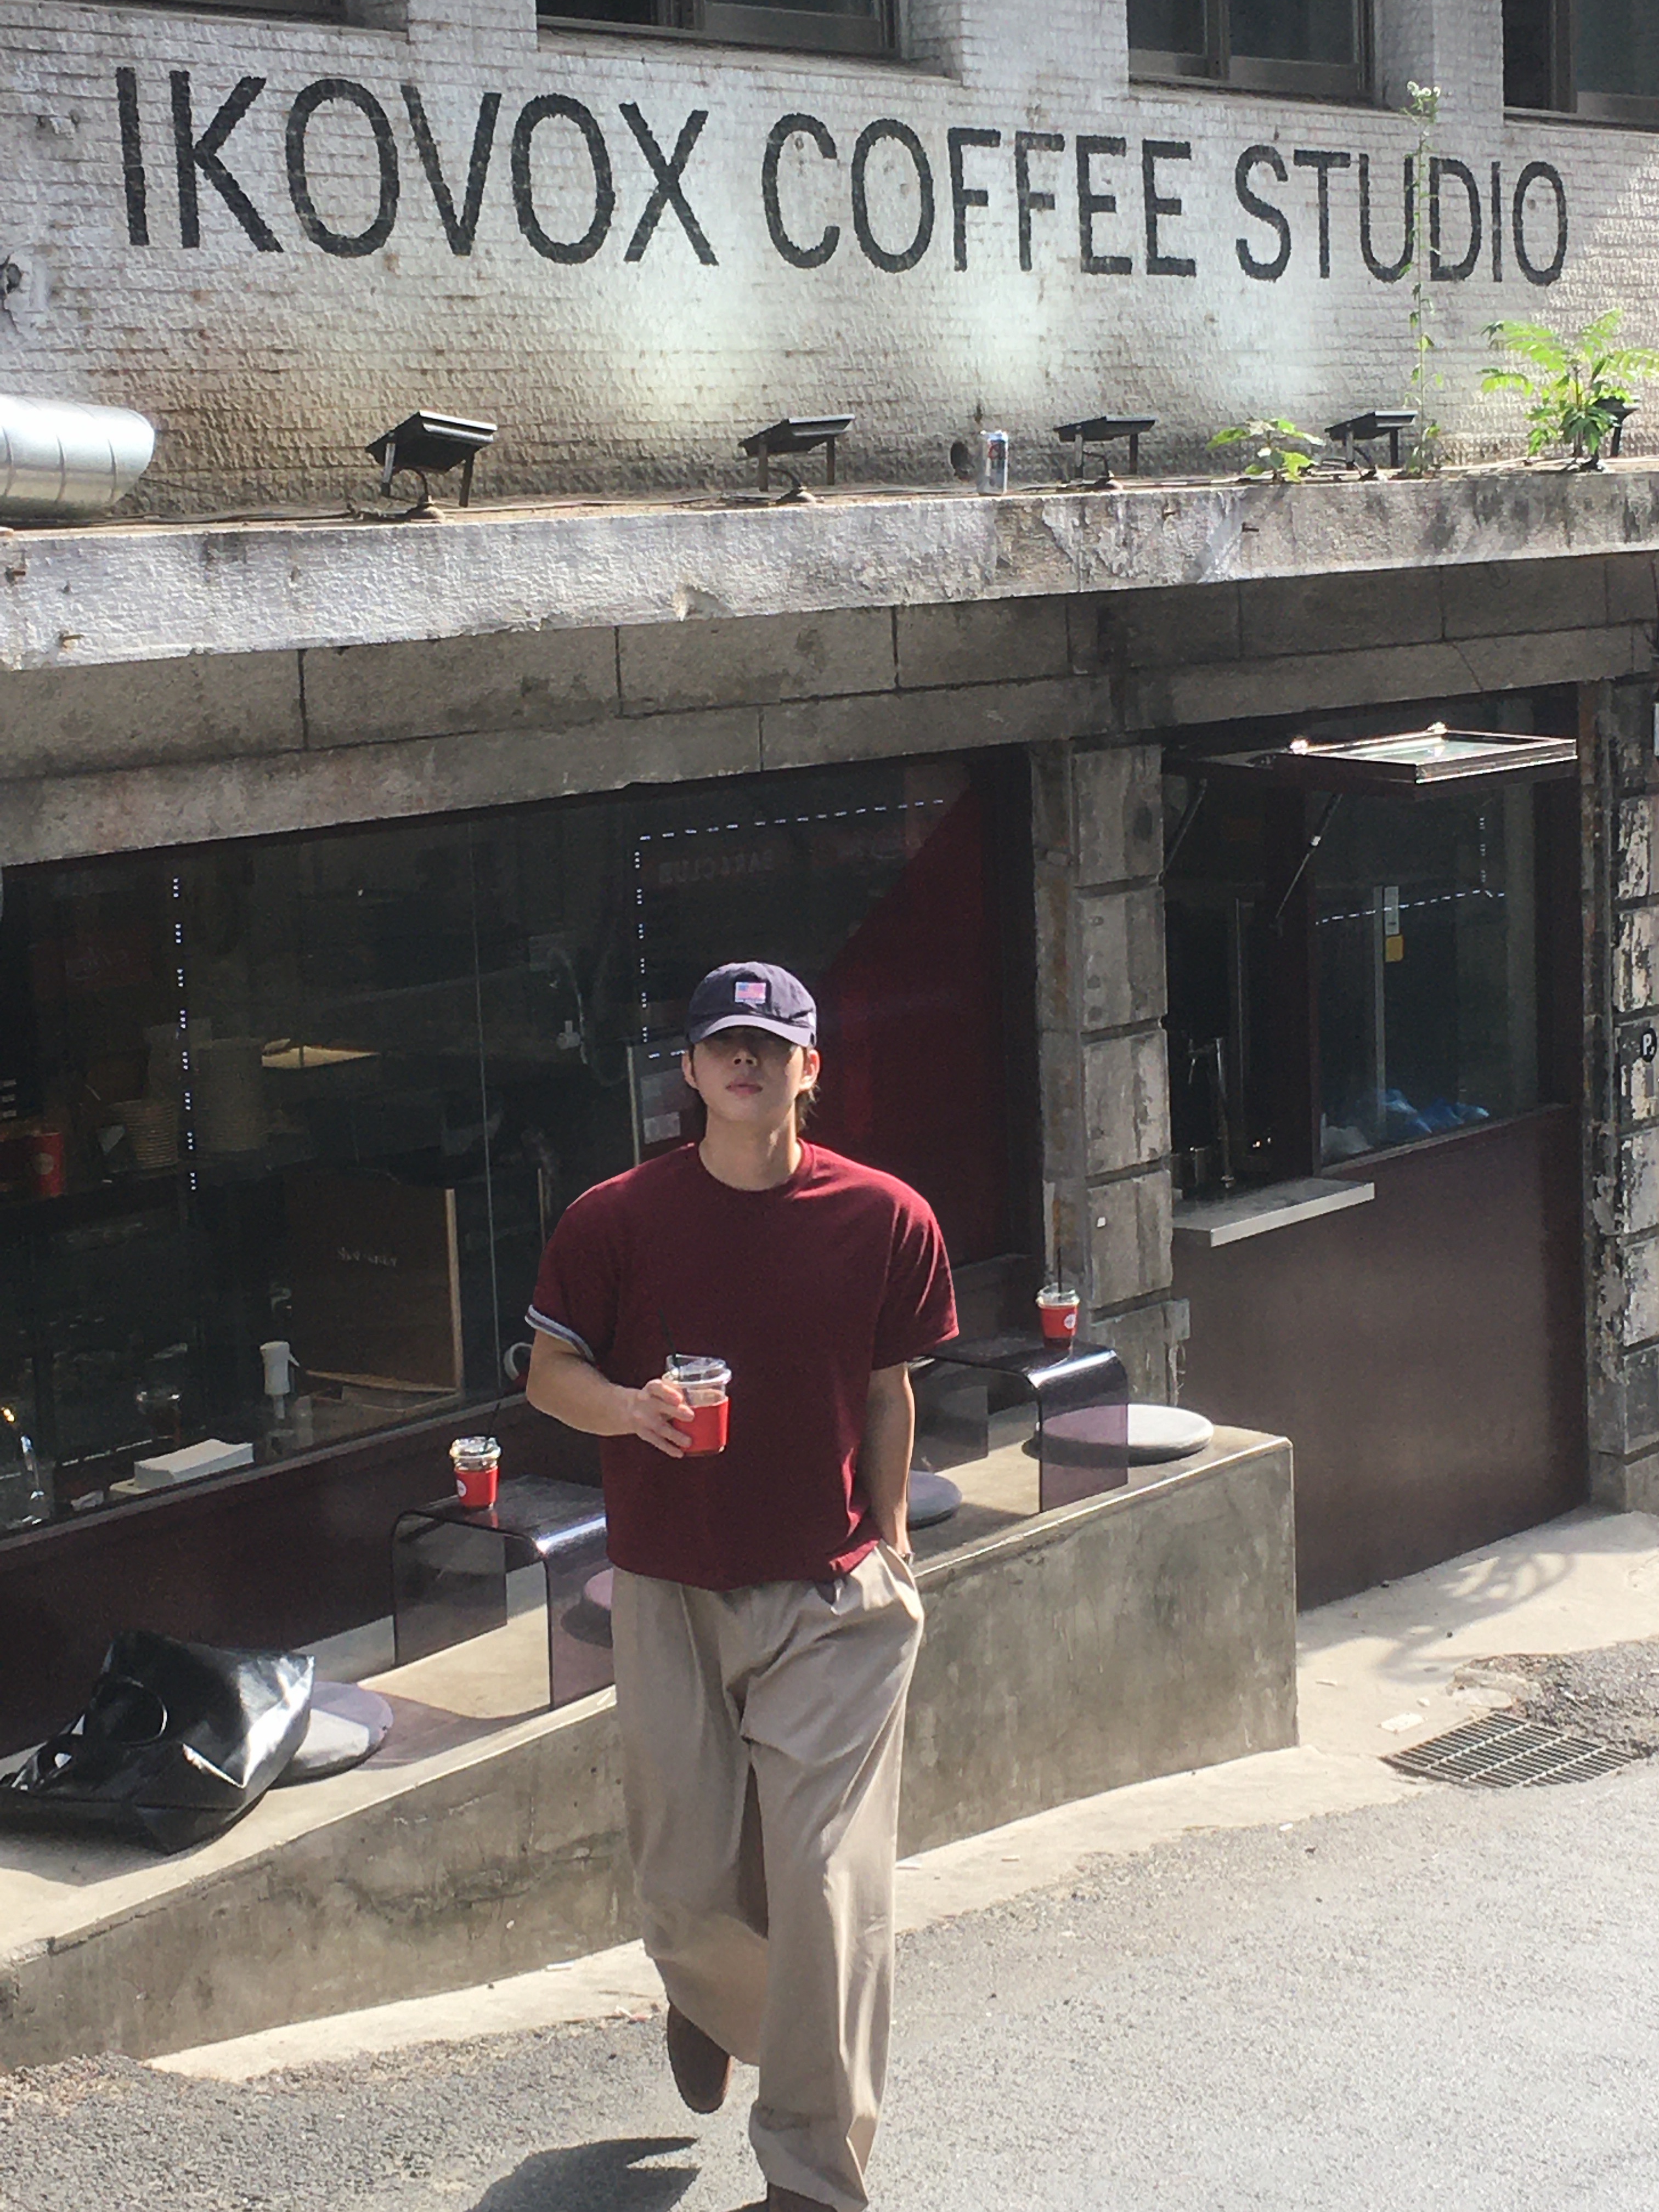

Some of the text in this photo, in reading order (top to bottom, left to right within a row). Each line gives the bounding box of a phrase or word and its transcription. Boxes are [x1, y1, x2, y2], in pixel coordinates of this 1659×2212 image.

[116, 66, 1568, 286] IKOVOX COFFEE STUDIO
